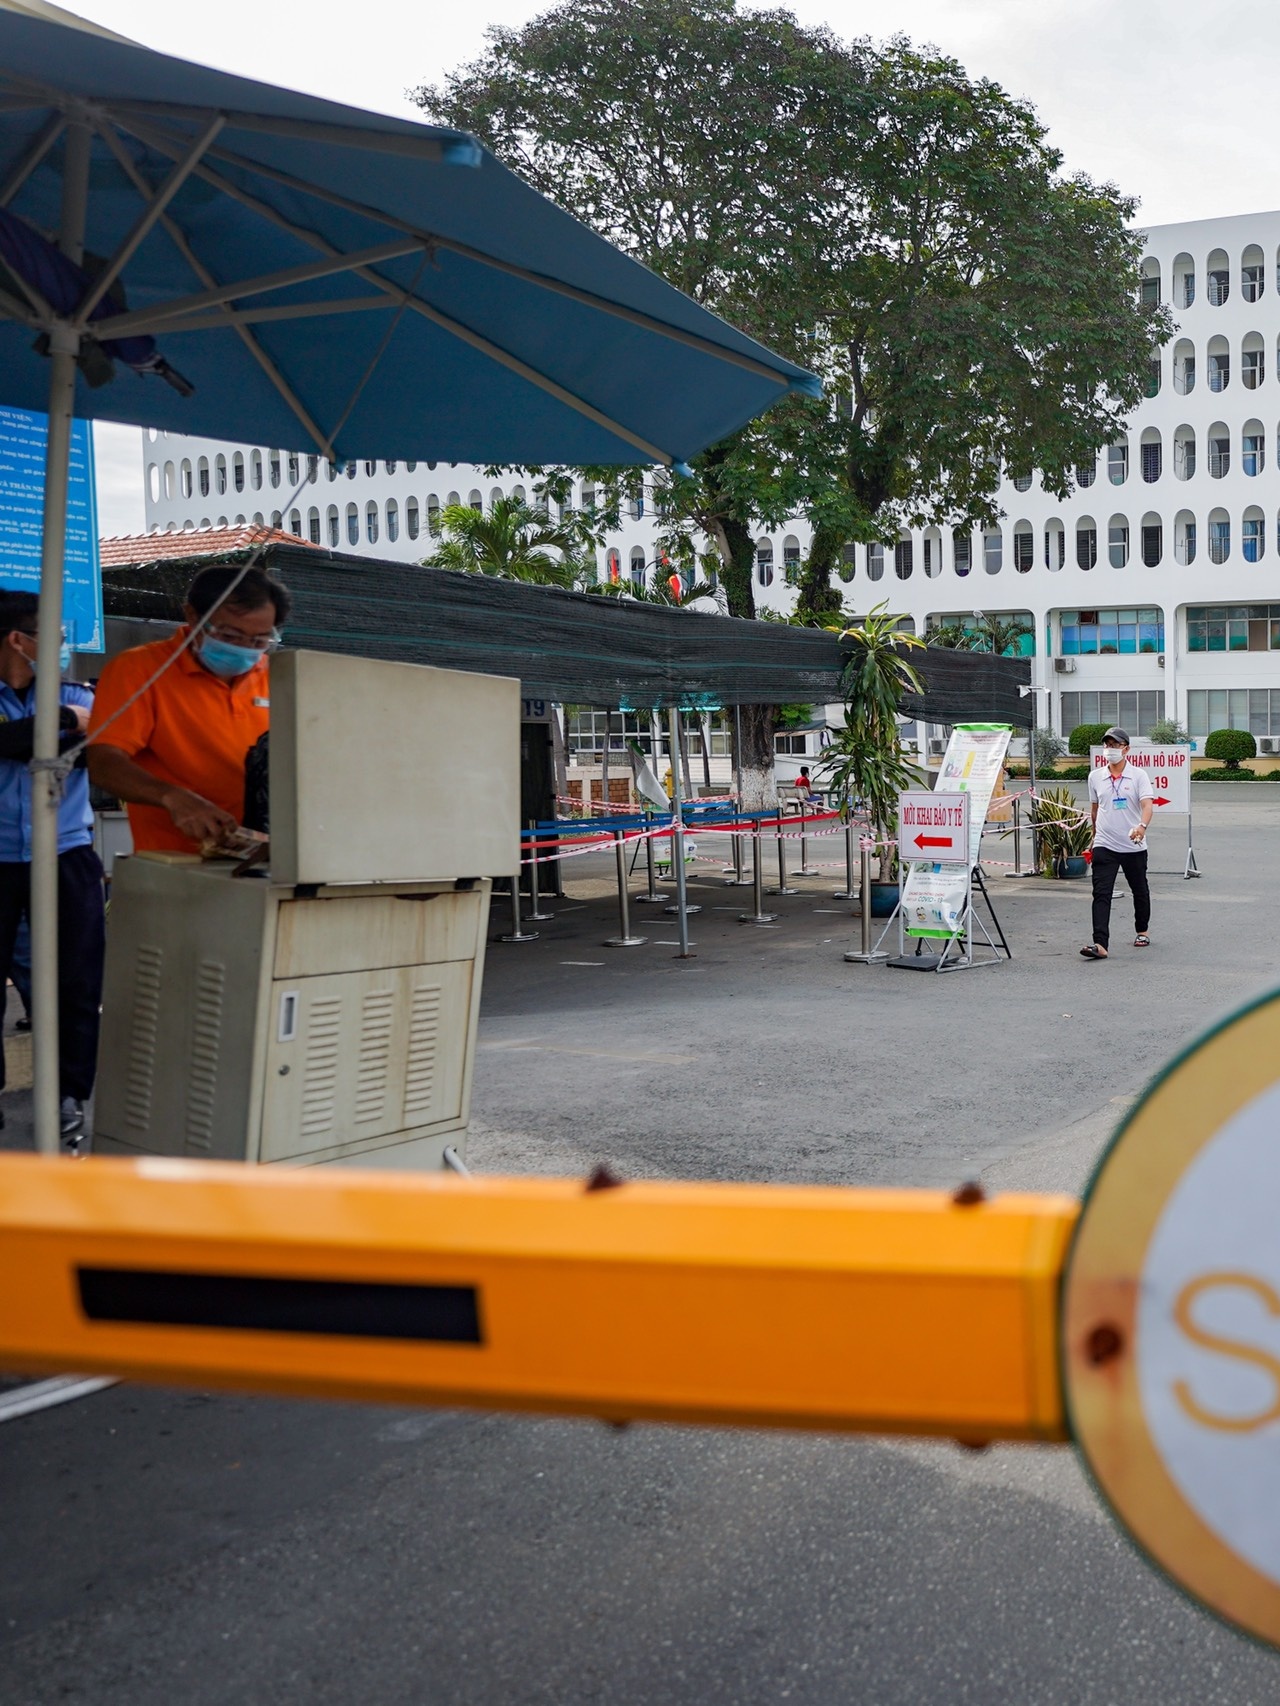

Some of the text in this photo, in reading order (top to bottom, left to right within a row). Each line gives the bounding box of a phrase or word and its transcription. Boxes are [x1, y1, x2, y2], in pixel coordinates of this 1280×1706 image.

[1126, 751, 1150, 767] KHÁM
[1153, 751, 1165, 767] HÔ
[1168, 750, 1185, 767] HẤP
[904, 800, 963, 826] MỜI KHAI BÁO Y TẾ
